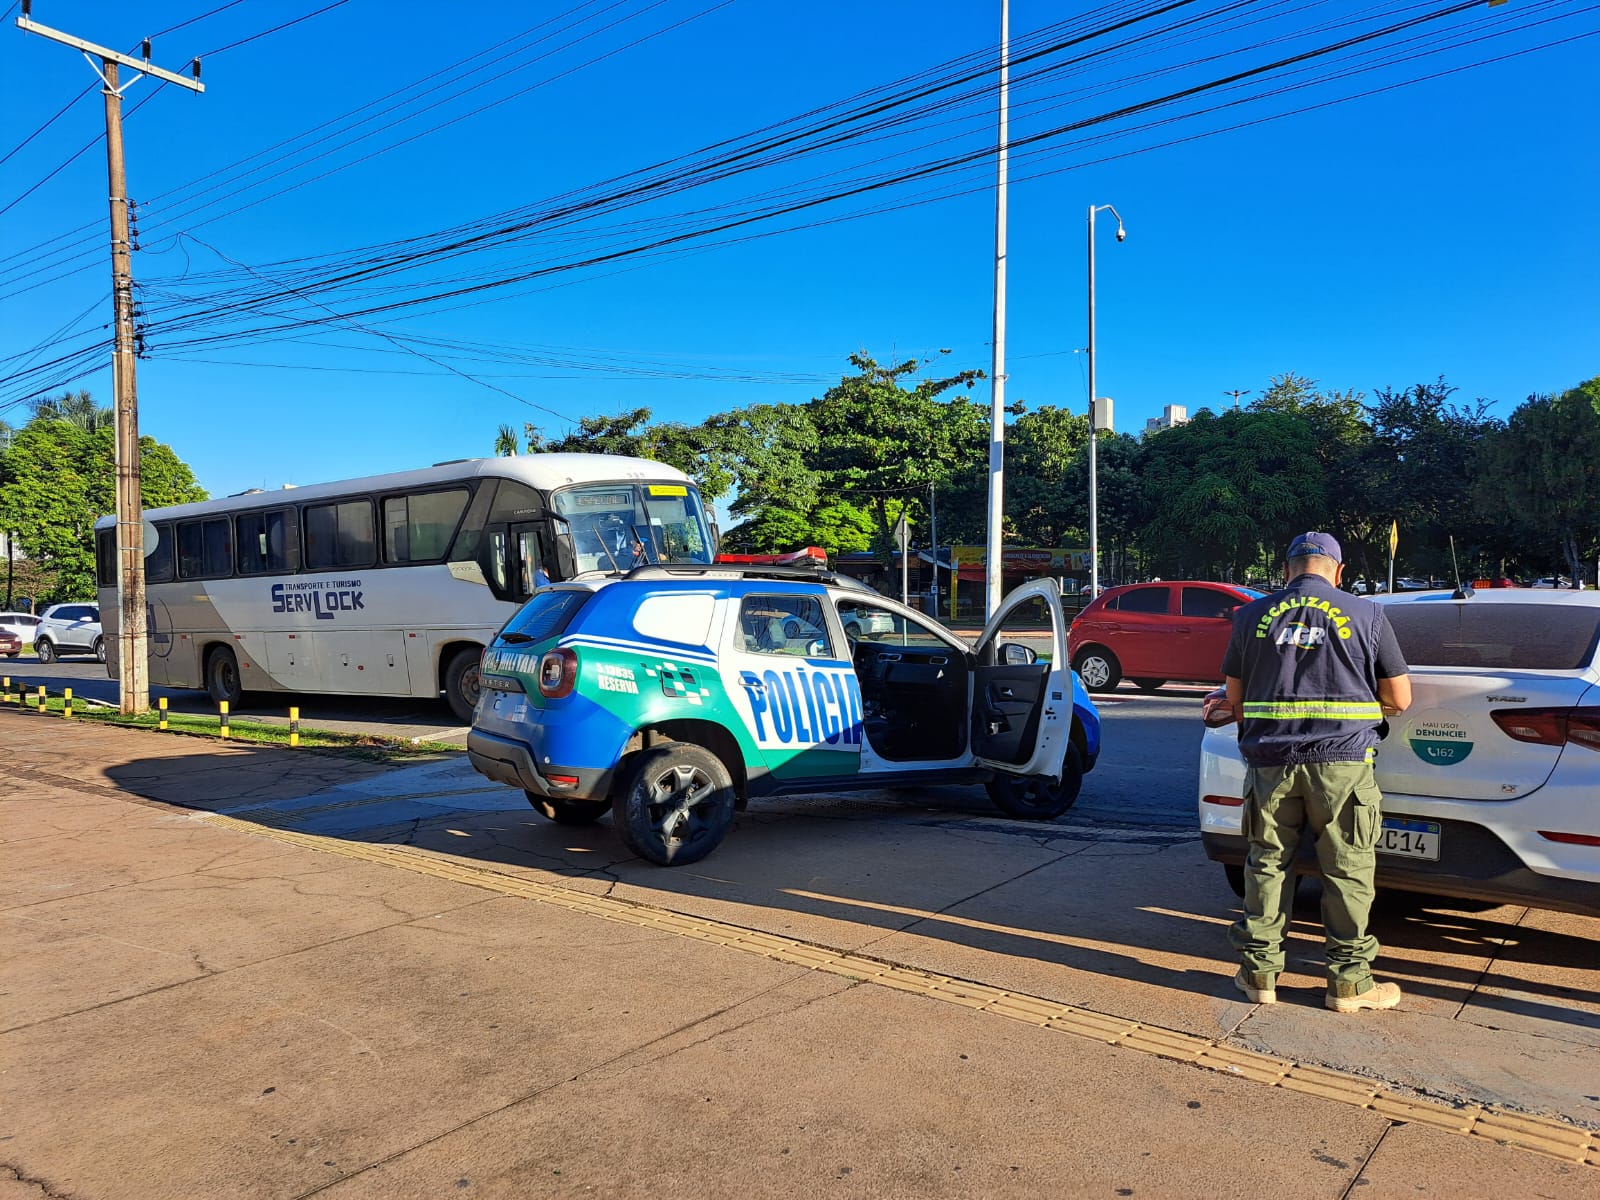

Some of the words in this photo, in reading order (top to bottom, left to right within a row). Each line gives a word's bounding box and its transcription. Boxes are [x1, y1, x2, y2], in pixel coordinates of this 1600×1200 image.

[285, 582, 324, 591] TRANSPORTE
[326, 581, 331, 589] E
[332, 579, 362, 589] TURISMO
[271, 583, 365, 620] SERVLOCK
[1255, 596, 1352, 640] FISCALIZAÇÃO
[1275, 624, 1326, 647] AGR
[597, 673, 640, 695] RESERVA
[739, 666, 864, 745] POLÍCIA
[1415, 729, 1467, 739] DENUNCIE!
[1436, 747, 1454, 758] 162
